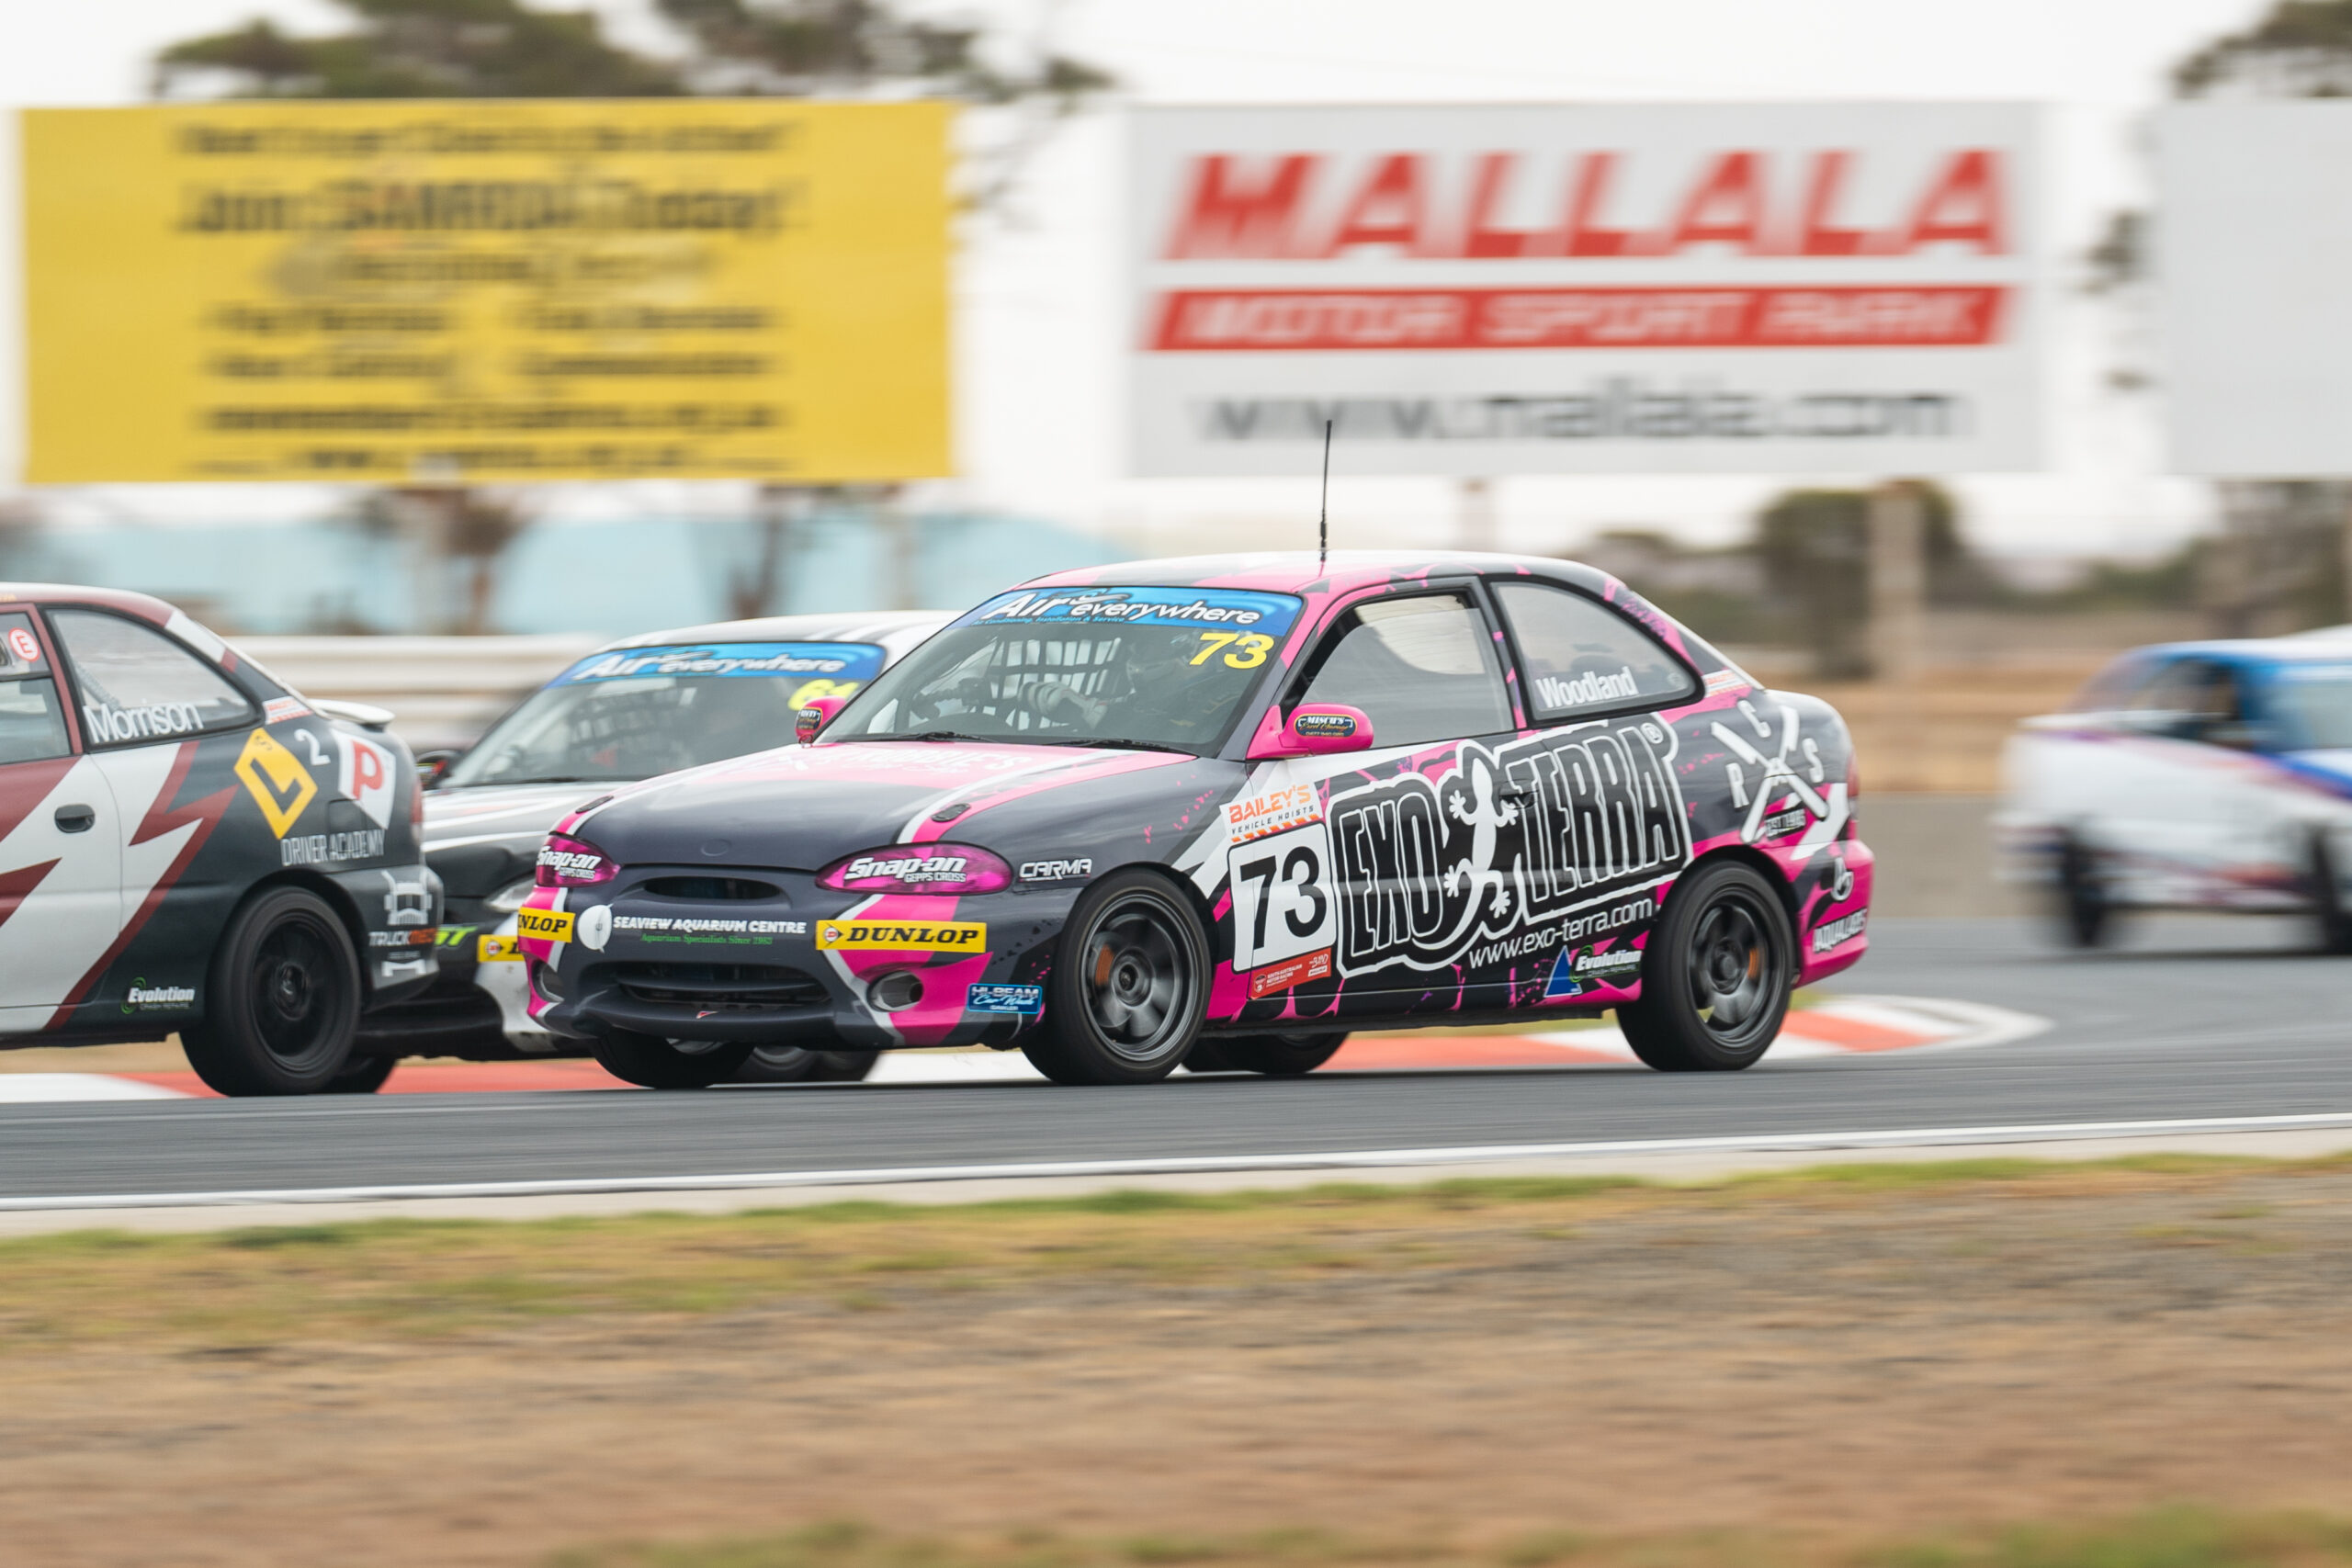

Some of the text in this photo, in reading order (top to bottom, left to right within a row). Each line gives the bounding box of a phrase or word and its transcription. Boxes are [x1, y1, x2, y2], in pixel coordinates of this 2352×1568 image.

[1163, 150, 2008, 261] MALLALA
[1180, 289, 1977, 344] MOTOR SPORT PARK
[1197, 376, 1973, 441] www.mallala.com
[983, 592, 1261, 625] Air everywhere
[16, 636, 33, 653] E
[1189, 633, 1274, 669] 73
[571, 654, 652, 681] Air
[1534, 666, 1639, 708] Woodland
[83, 698, 204, 744] Morrison
[294, 728, 331, 765] 2
[350, 739, 384, 801] P
[1228, 784, 1312, 824] BAILEY'S
[1231, 805, 1315, 835] VEHICLE HOISTS
[280, 829, 386, 866] DRIVER ACADEMY
[537, 846, 602, 871] Snap-on
[843, 857, 967, 881] Snap-on
[904, 872, 967, 883] GEPPS CROSS
[1019, 858, 1092, 881] CARMA
[1339, 791, 1444, 958] EXO
[1239, 846, 1328, 951] 73
[518, 914, 568, 933] NLOP
[613, 917, 807, 933] SEAVIEW AQUARIUM CENTRE
[846, 927, 979, 944] DUNLOP
[1468, 897, 1654, 969] www.exo-terra.com
[1576, 949, 1643, 971] Evolution
[128, 986, 196, 1004] Evolution
